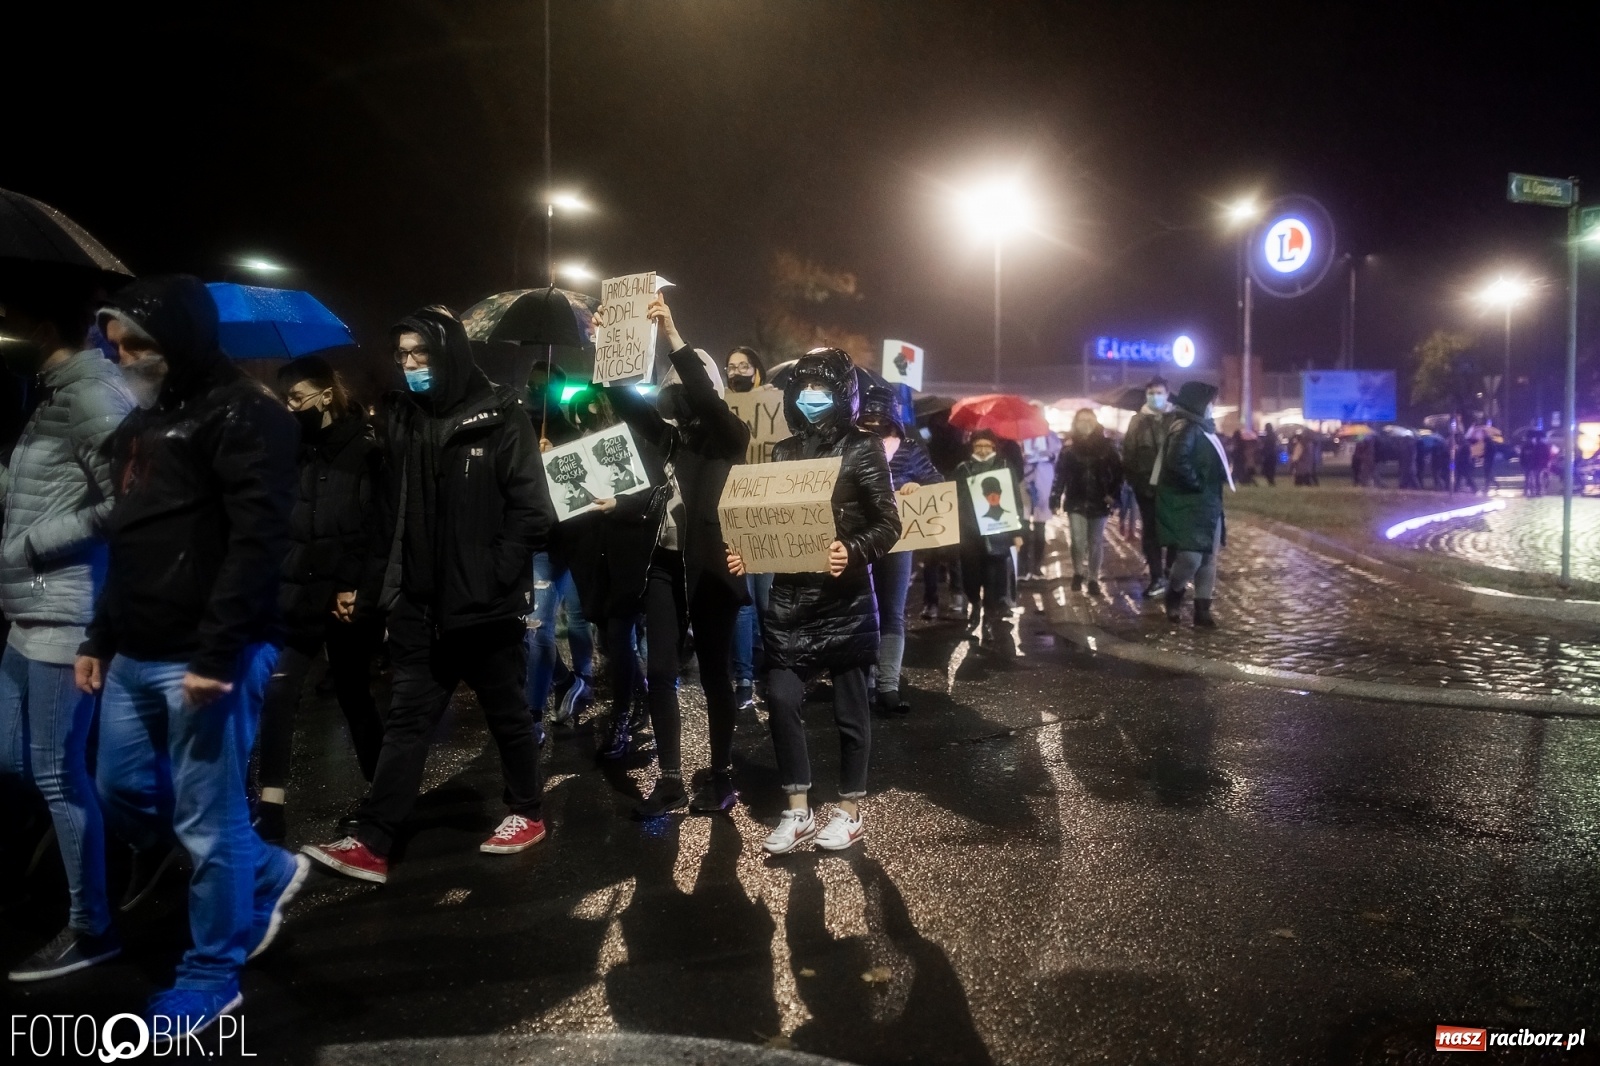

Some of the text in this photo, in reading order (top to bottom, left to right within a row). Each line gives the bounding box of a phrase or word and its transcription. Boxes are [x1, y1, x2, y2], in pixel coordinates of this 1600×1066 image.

[1277, 233, 1296, 262] L
[626, 327, 635, 341] W
[603, 436, 621, 449] BOLI
[605, 444, 623, 456] MNIE
[557, 454, 576, 468] BOLI
[600, 450, 630, 465] POLSKA
[560, 461, 577, 474] MNIE
[555, 468, 584, 483] POLSKA
[728, 470, 835, 499] NAWET SHREK
[902, 491, 953, 518] NAS
[723, 507, 742, 530] NIE
[902, 516, 946, 539] AS
[743, 532, 784, 561] TAKIM
[784, 532, 831, 559] BAGNIE
